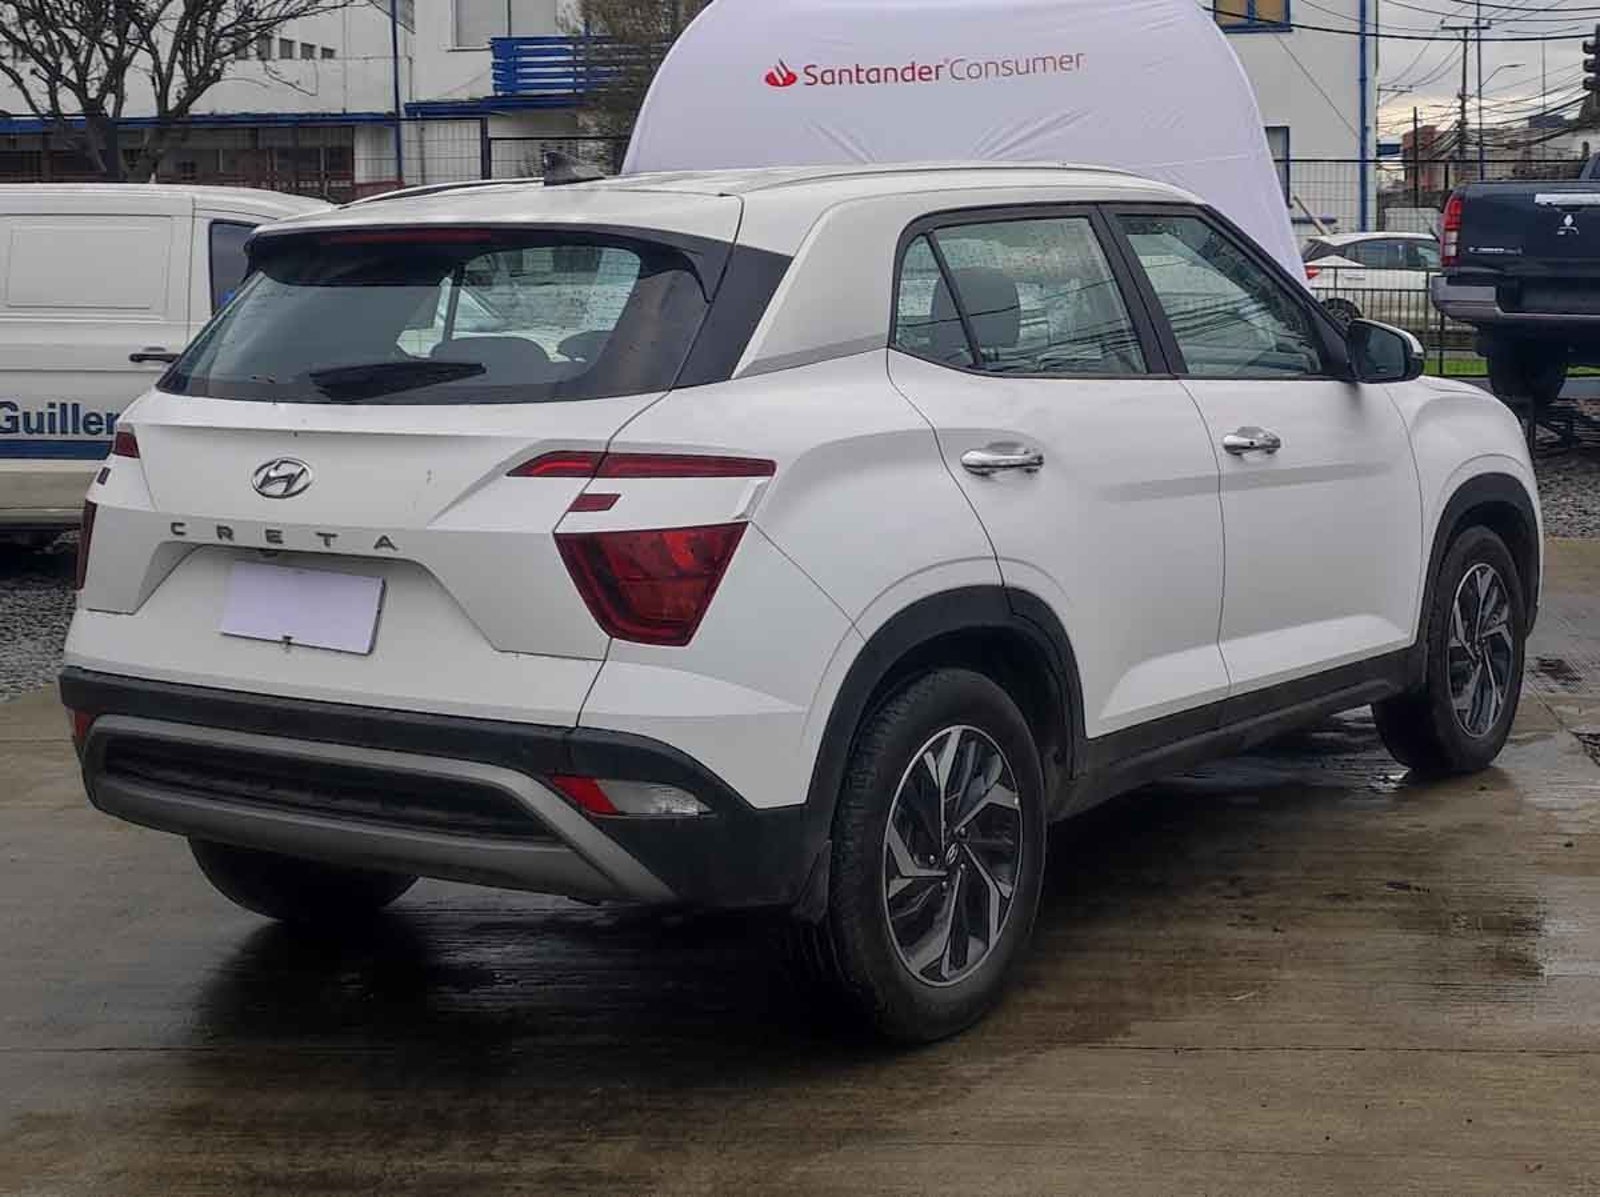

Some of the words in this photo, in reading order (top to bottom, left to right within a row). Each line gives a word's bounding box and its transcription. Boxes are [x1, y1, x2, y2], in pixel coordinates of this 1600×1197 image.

[803, 61, 944, 86] Santander
[949, 52, 1085, 82] Consumer
[170, 521, 399, 551] CRETA
